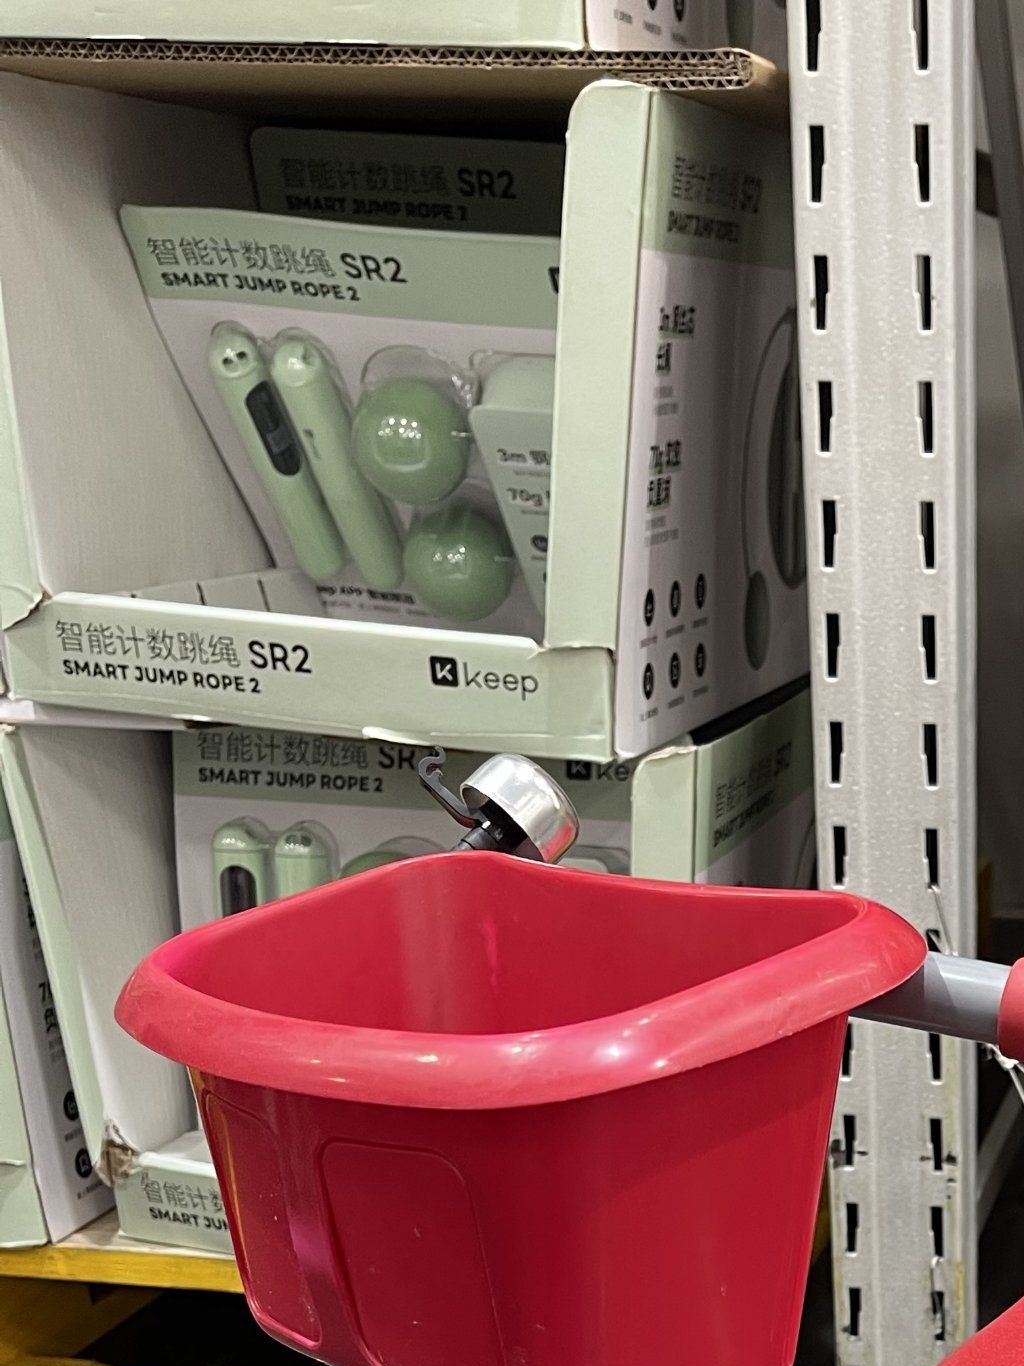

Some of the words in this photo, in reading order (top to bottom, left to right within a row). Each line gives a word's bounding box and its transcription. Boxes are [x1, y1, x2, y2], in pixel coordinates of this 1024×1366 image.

[457, 167, 517, 200] SR2
[286, 195, 346, 213] SMART
[352, 199, 401, 217] JUMP
[405, 203, 454, 221] ROPE
[147, 237, 336, 278] 智能计数跳绳
[340, 252, 409, 284] SR2
[161, 271, 231, 289] SMART
[234, 273, 287, 295] JUMP
[291, 279, 346, 301] ROPE
[347, 286, 361, 302] 2
[56, 619, 241, 669] 智能计数跳绳
[247, 639, 313, 675] SR2
[62, 658, 131, 682] SMART
[134, 665, 189, 686] JUMP
[193, 671, 247, 693] ROPE
[249, 677, 263, 694] 2
[462, 661, 540, 702] keep
[196, 730, 369, 770] 智能计数跳绳
[378, 745, 424, 771] SR
[198, 766, 263, 787] SMART
[266, 770, 317, 790] JUMP
[320, 774, 370, 792] ROPE
[373, 777, 385, 794] 2
[597, 764, 631, 782] ke
[141, 1171, 222, 1213] 智能计数
[148, 1206, 200, 1228] SMART
[203, 1215, 228, 1231] JU
